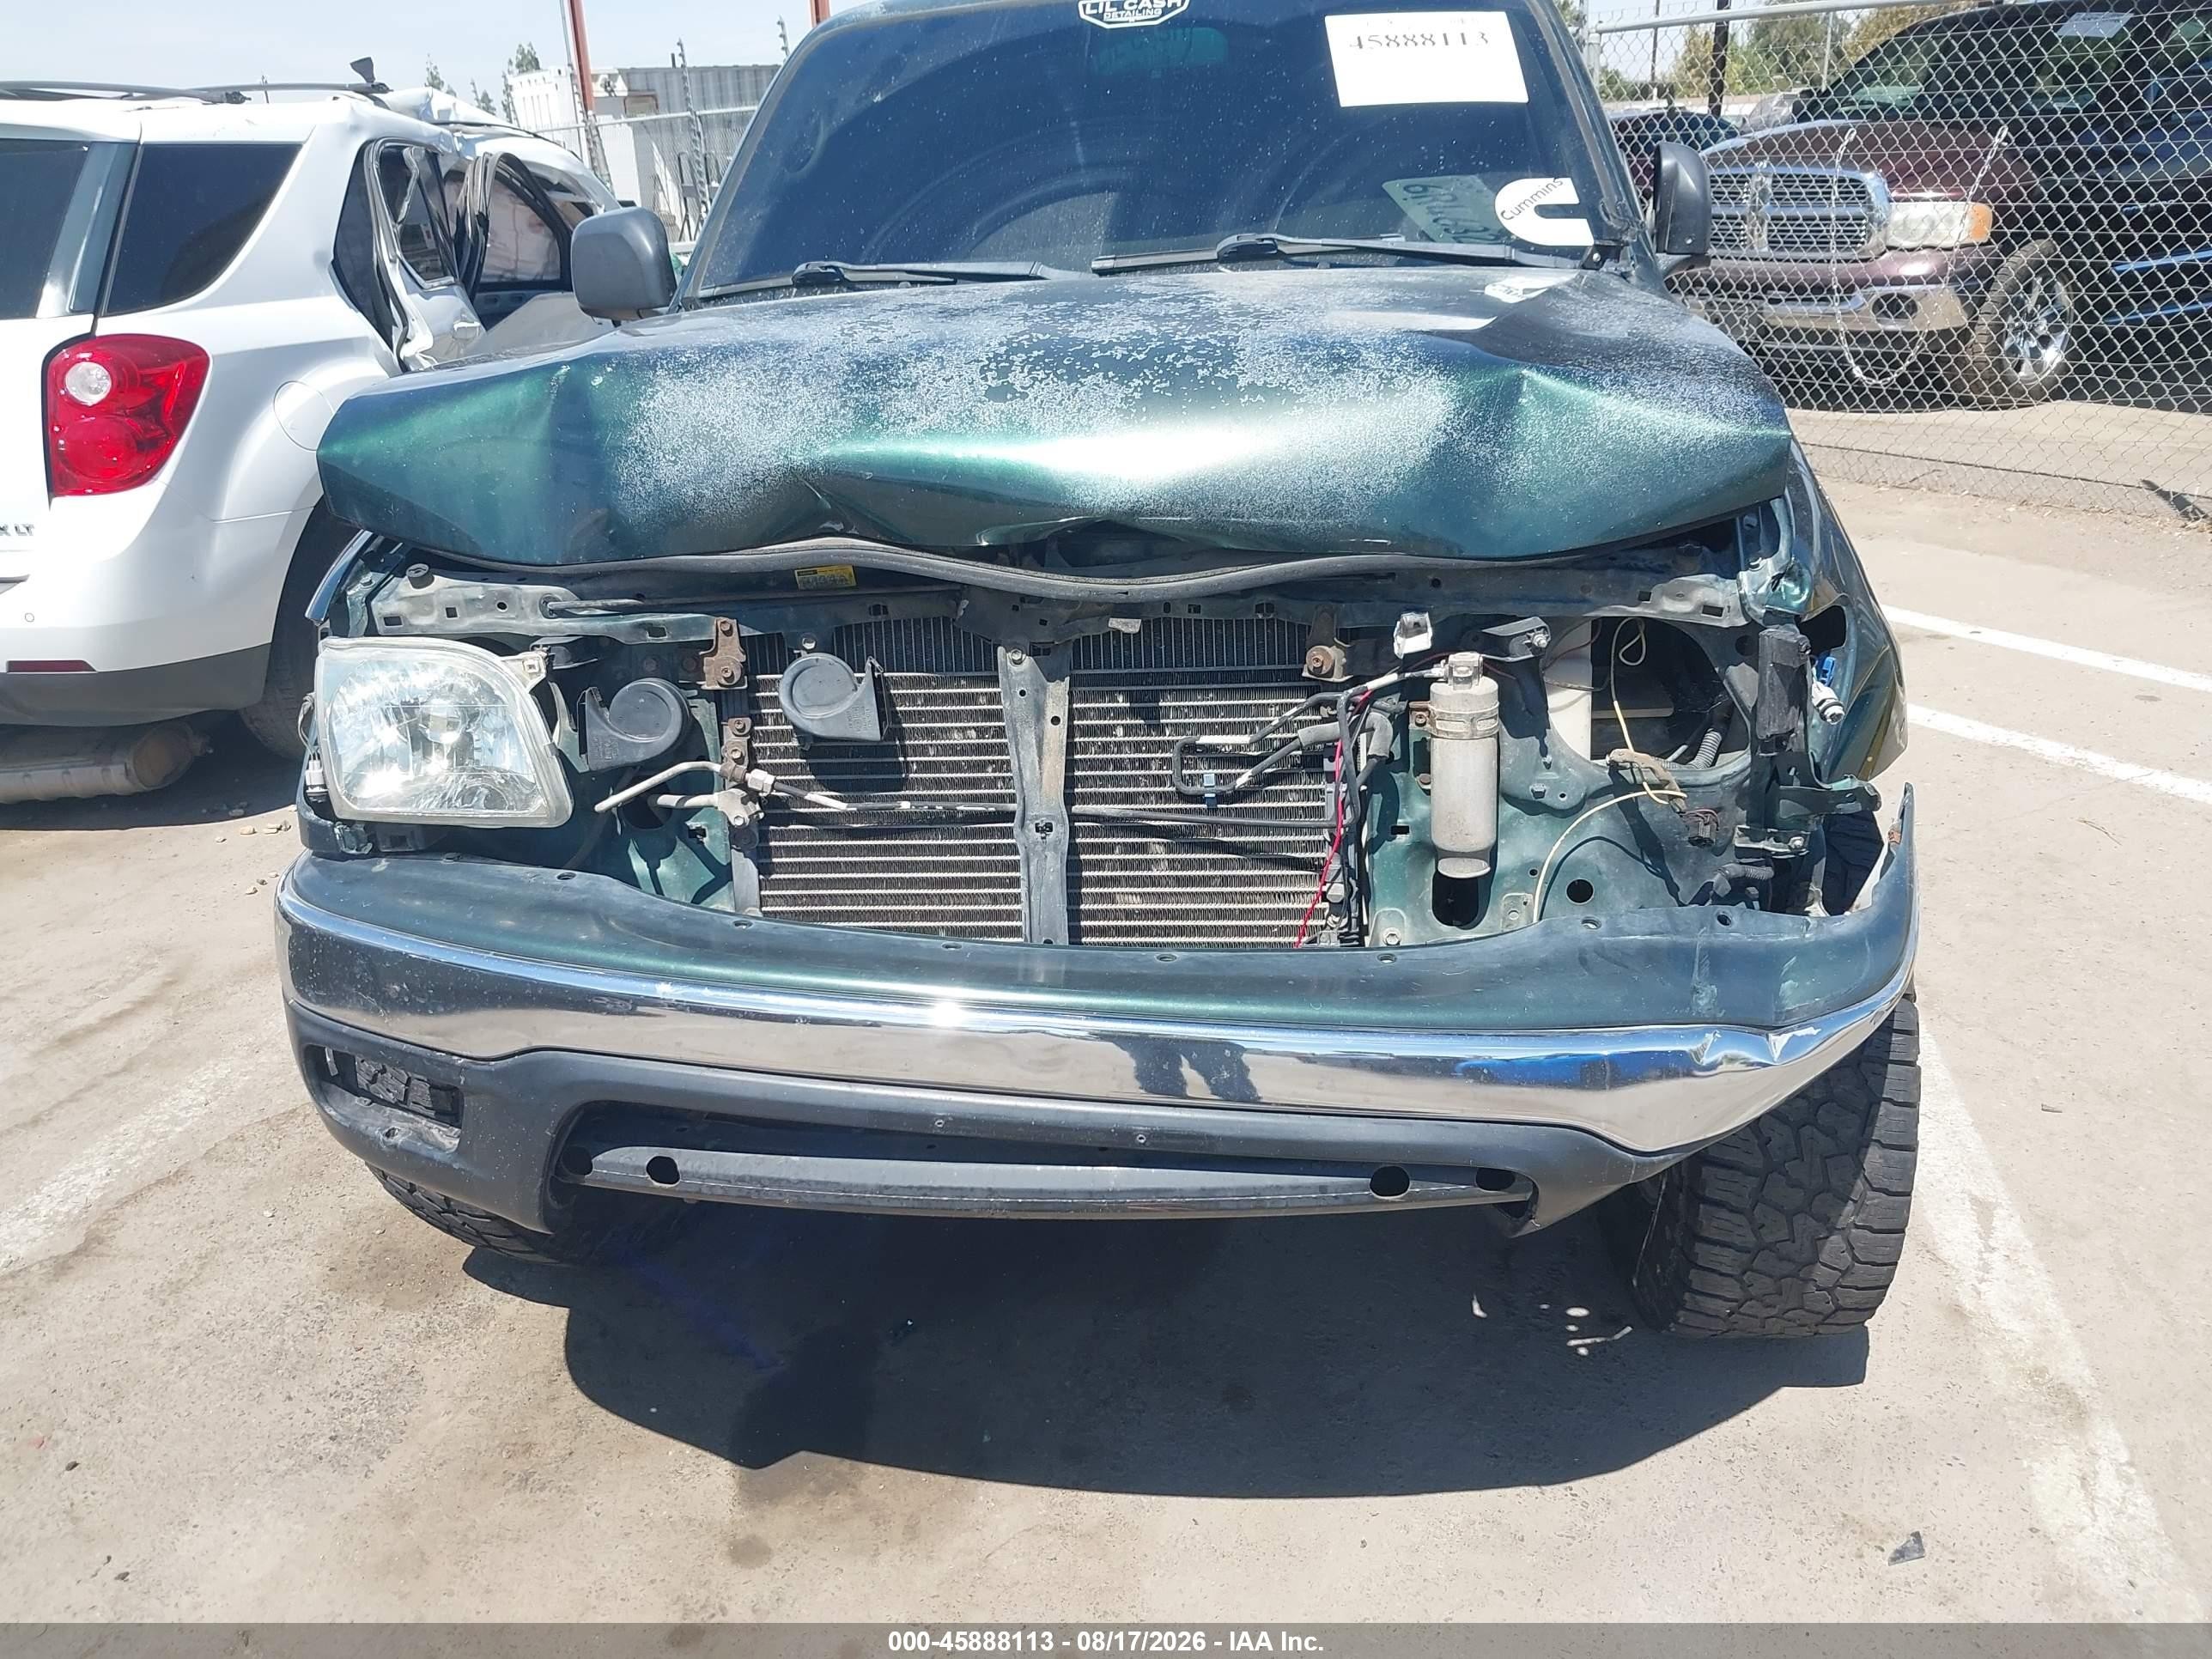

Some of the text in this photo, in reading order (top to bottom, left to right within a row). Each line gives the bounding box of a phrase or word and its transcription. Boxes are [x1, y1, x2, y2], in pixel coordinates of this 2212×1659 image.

[1085, 0, 1182, 15] LIL CASH
[1103, 8, 1163, 20] DETAILING
[1349, 31, 1490, 50] 45888113
[1500, 177, 1564, 221] Cummins
[14, 523, 34, 537] LT
